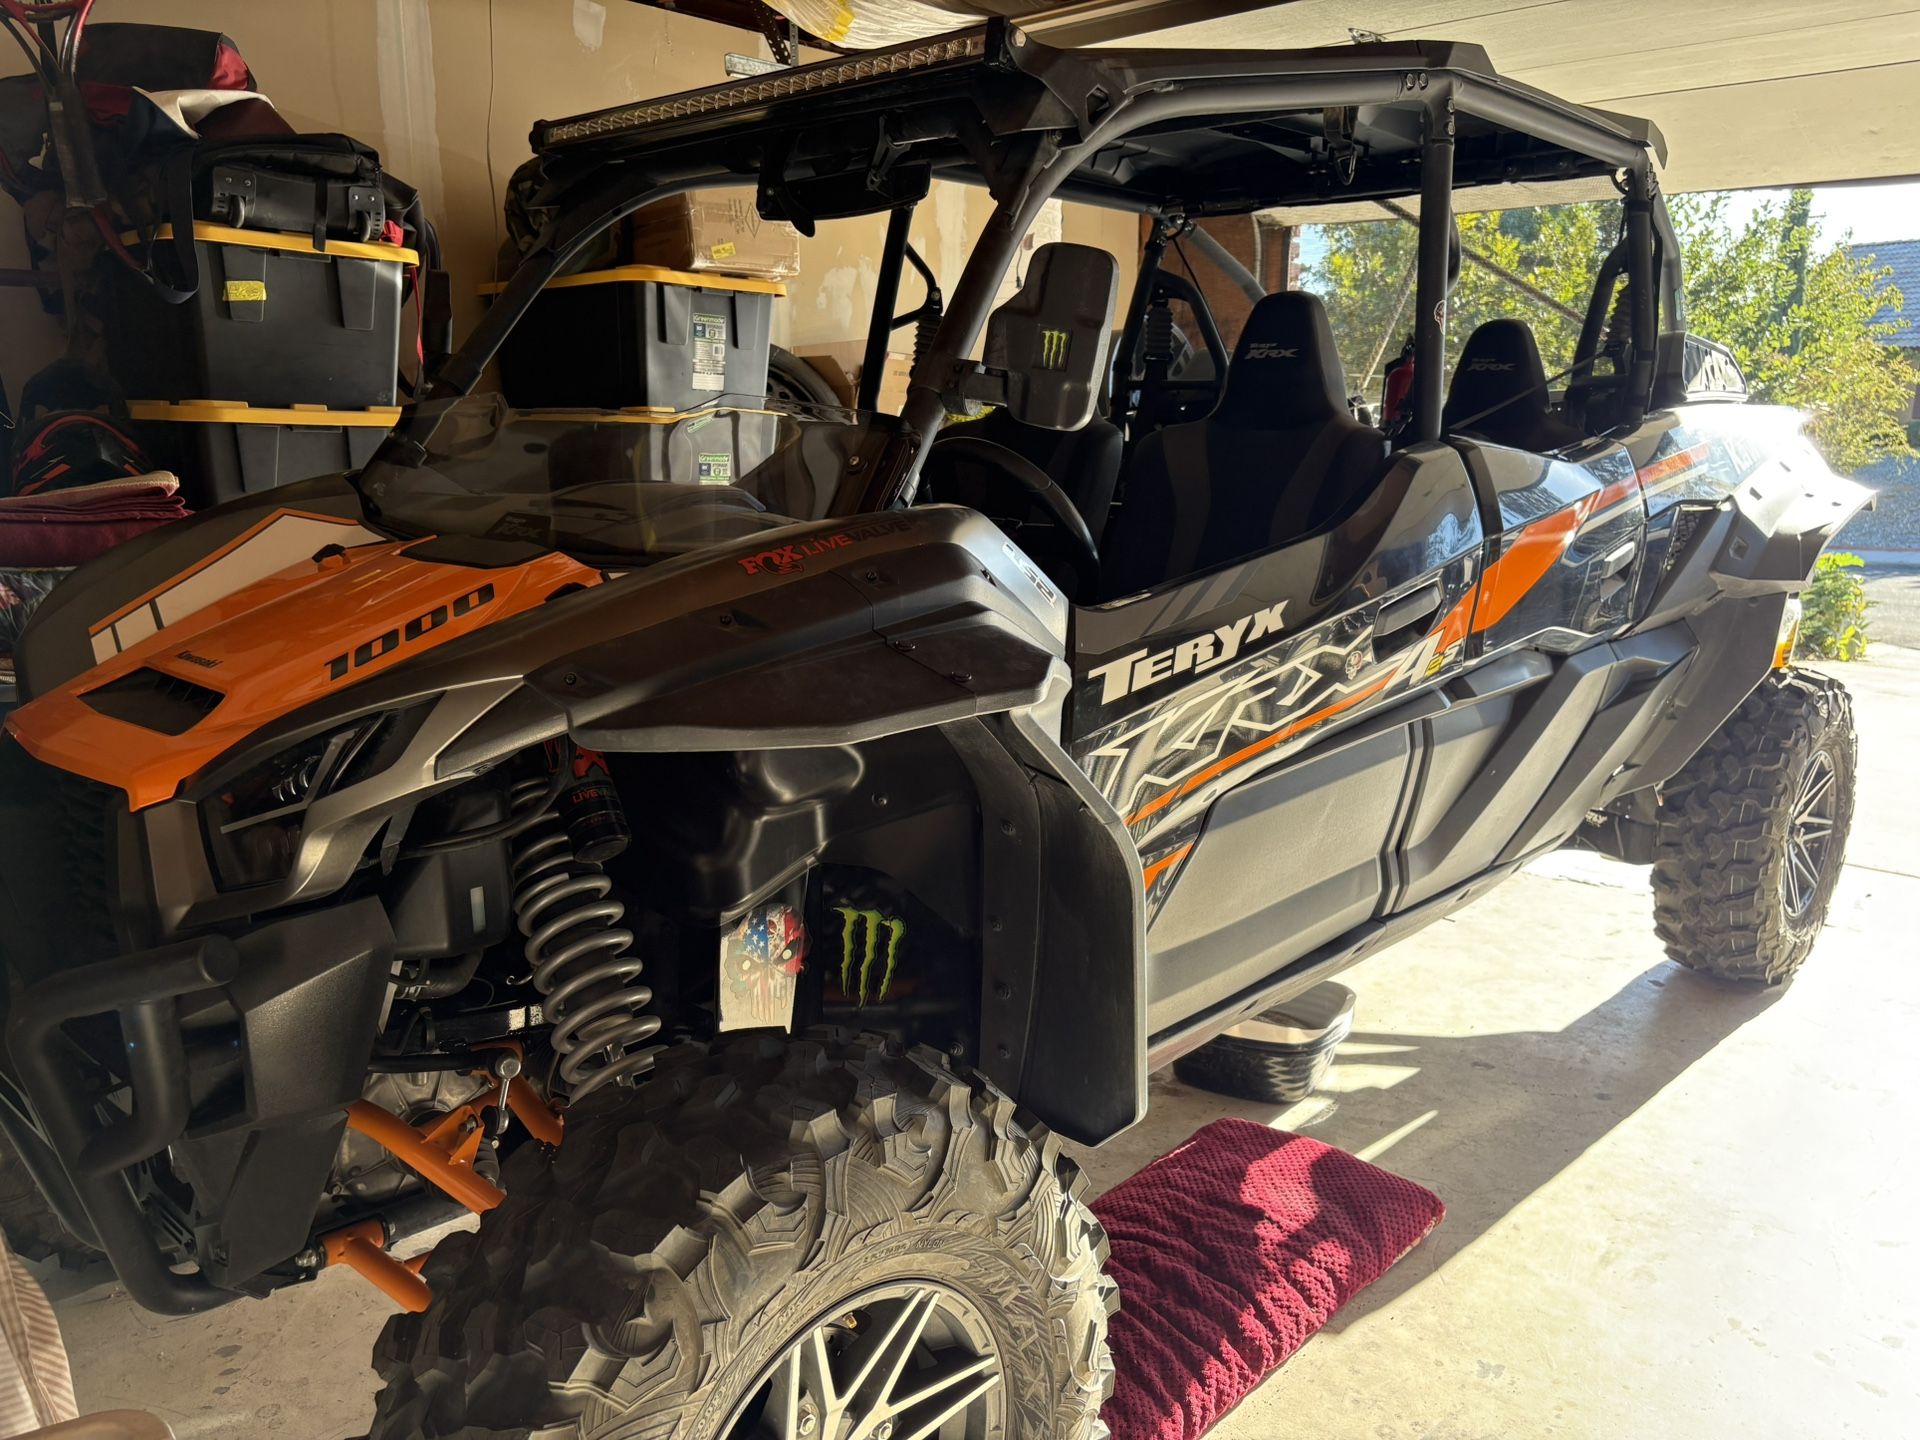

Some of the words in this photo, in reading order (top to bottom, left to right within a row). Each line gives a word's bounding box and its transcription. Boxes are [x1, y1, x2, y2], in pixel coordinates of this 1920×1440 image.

[738, 544, 804, 576] FOX
[324, 583, 495, 681] 1000
[1087, 600, 1289, 706] TERYX
